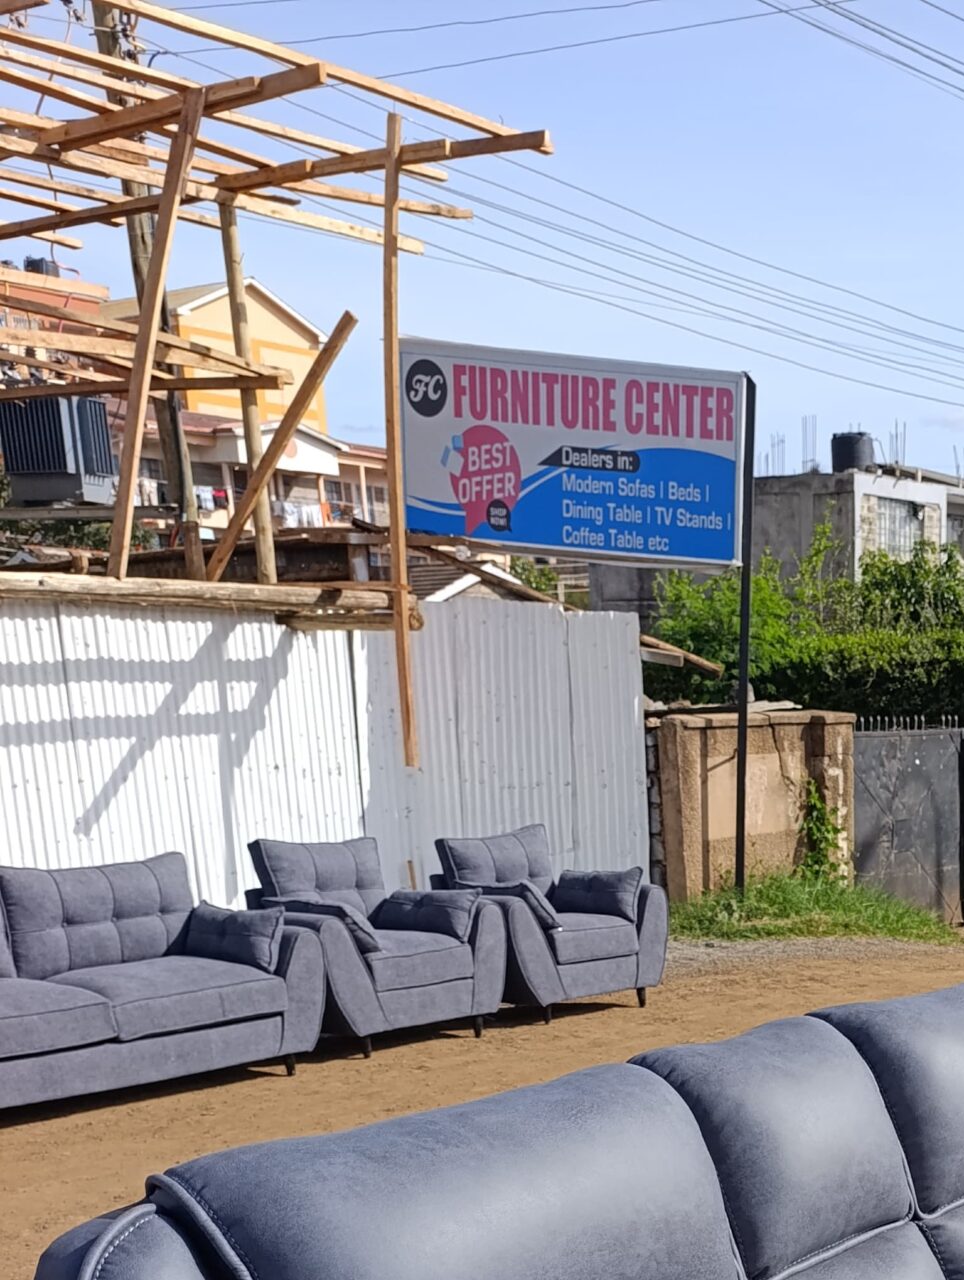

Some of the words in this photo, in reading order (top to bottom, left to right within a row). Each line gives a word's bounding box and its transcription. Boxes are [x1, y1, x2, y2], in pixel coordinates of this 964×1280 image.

[453, 364, 616, 432] FURNITURE
[624, 379, 734, 442] CENTER
[468, 442, 512, 472] BEST
[561, 447, 613, 469] Dealers
[617, 452, 633, 470] in:
[458, 472, 515, 504] OFFER
[562, 473, 614, 495] Modern
[618, 477, 655, 499] Sofas
[668, 481, 701, 502] Beds
[562, 499, 603, 525] Dining
[607, 503, 642, 524] Table
[655, 507, 673, 526] TV
[676, 508, 723, 530] Stands
[562, 525, 604, 546] Coffee
[608, 529, 644, 549] Table
[648, 535, 669, 551] etc
